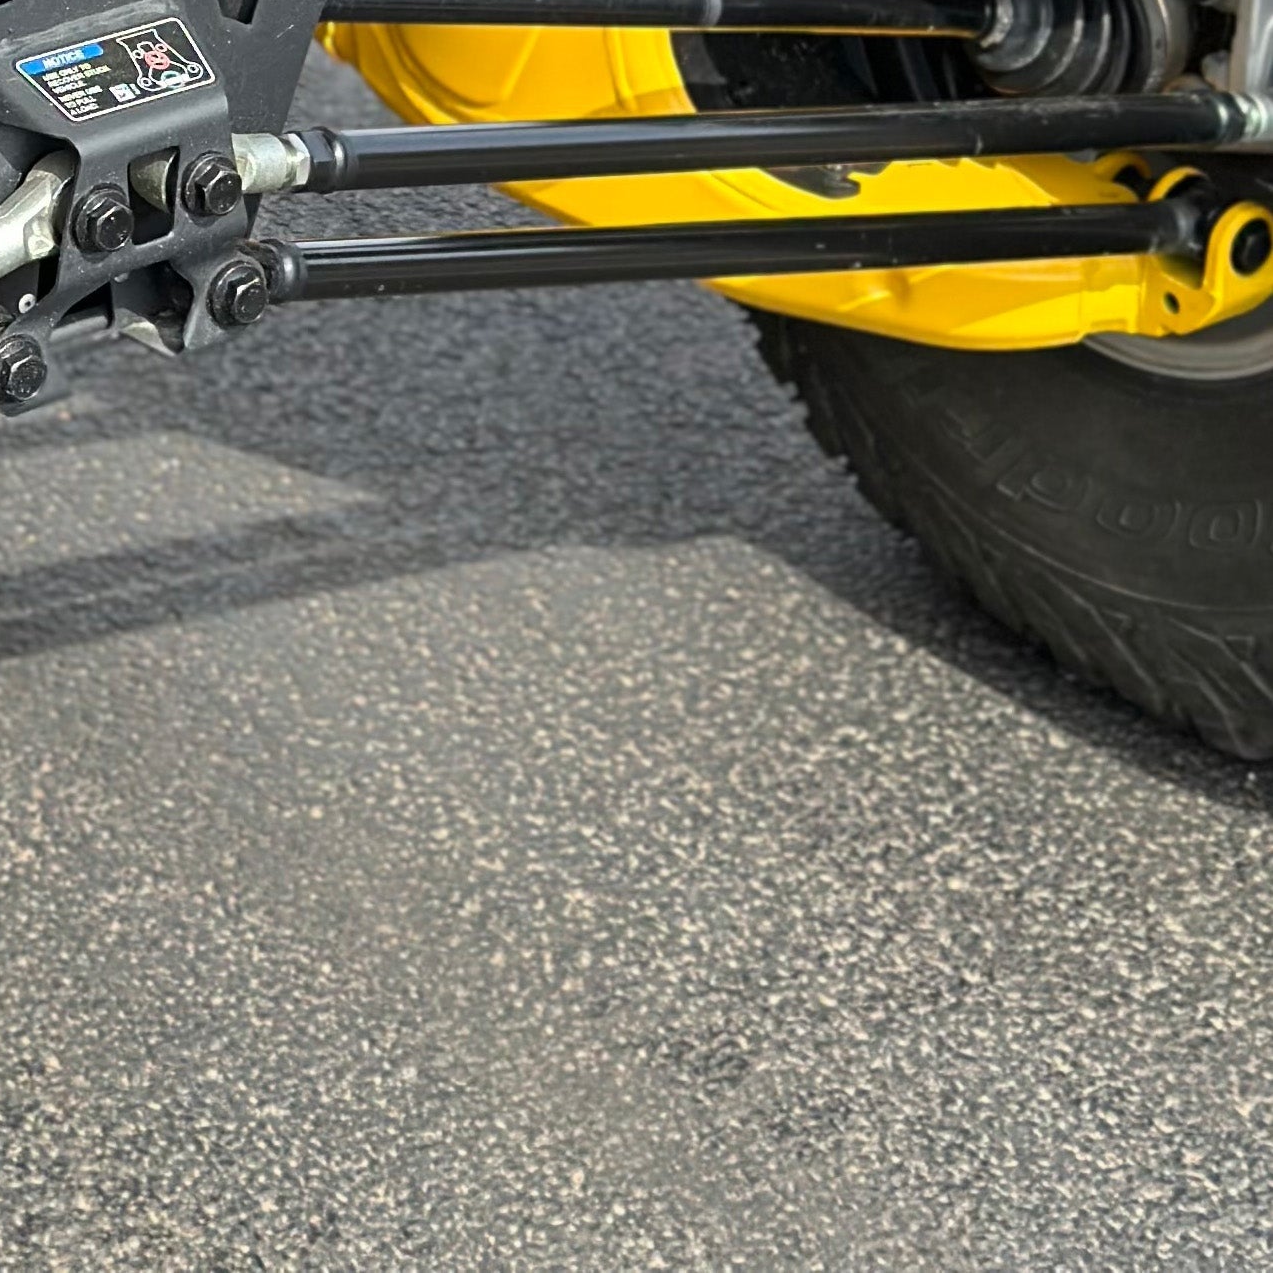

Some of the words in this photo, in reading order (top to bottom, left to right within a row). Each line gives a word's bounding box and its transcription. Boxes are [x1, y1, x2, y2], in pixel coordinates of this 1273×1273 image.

[42, 50, 85, 70] NOTICE
[47, 72, 86, 88] RECOVER
[83, 64, 112, 78] STUCK
[58, 65, 79, 77] ONLY
[78, 62, 92, 71] TO
[58, 90, 87, 103] NEVER
[85, 85, 103, 95] USE
[64, 100, 77, 109] TO
[75, 95, 97, 106] PULL
[70, 108, 78, 116] A
